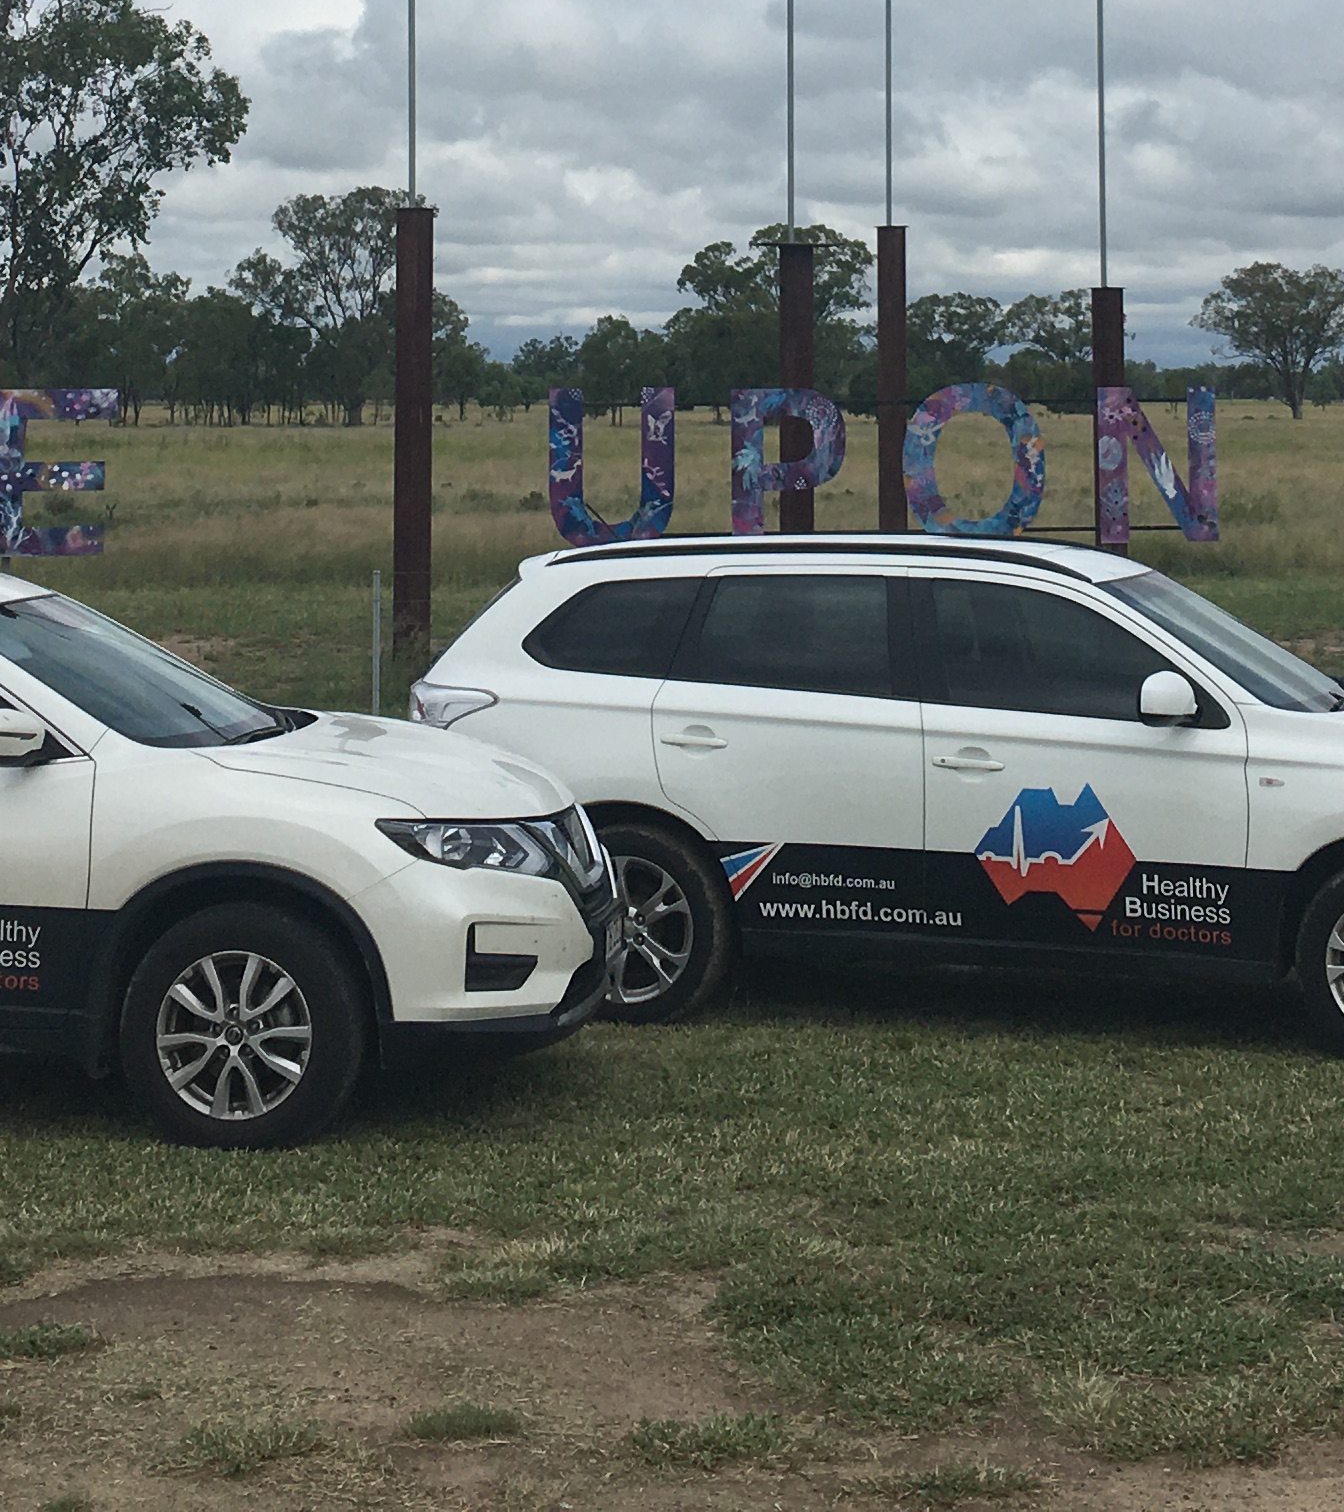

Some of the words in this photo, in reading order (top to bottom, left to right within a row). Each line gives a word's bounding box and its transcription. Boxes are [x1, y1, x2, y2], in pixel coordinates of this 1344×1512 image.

[549, 383, 1219, 545] UPON
[773, 873, 895, 890] info@hbfd.com.au
[1142, 873, 1229, 905] Healthy
[760, 900, 962, 926] www.hbfd.com.au
[1125, 896, 1231, 924] Business
[1111, 920, 1141, 937] for
[1149, 922, 1232, 944] doctors
